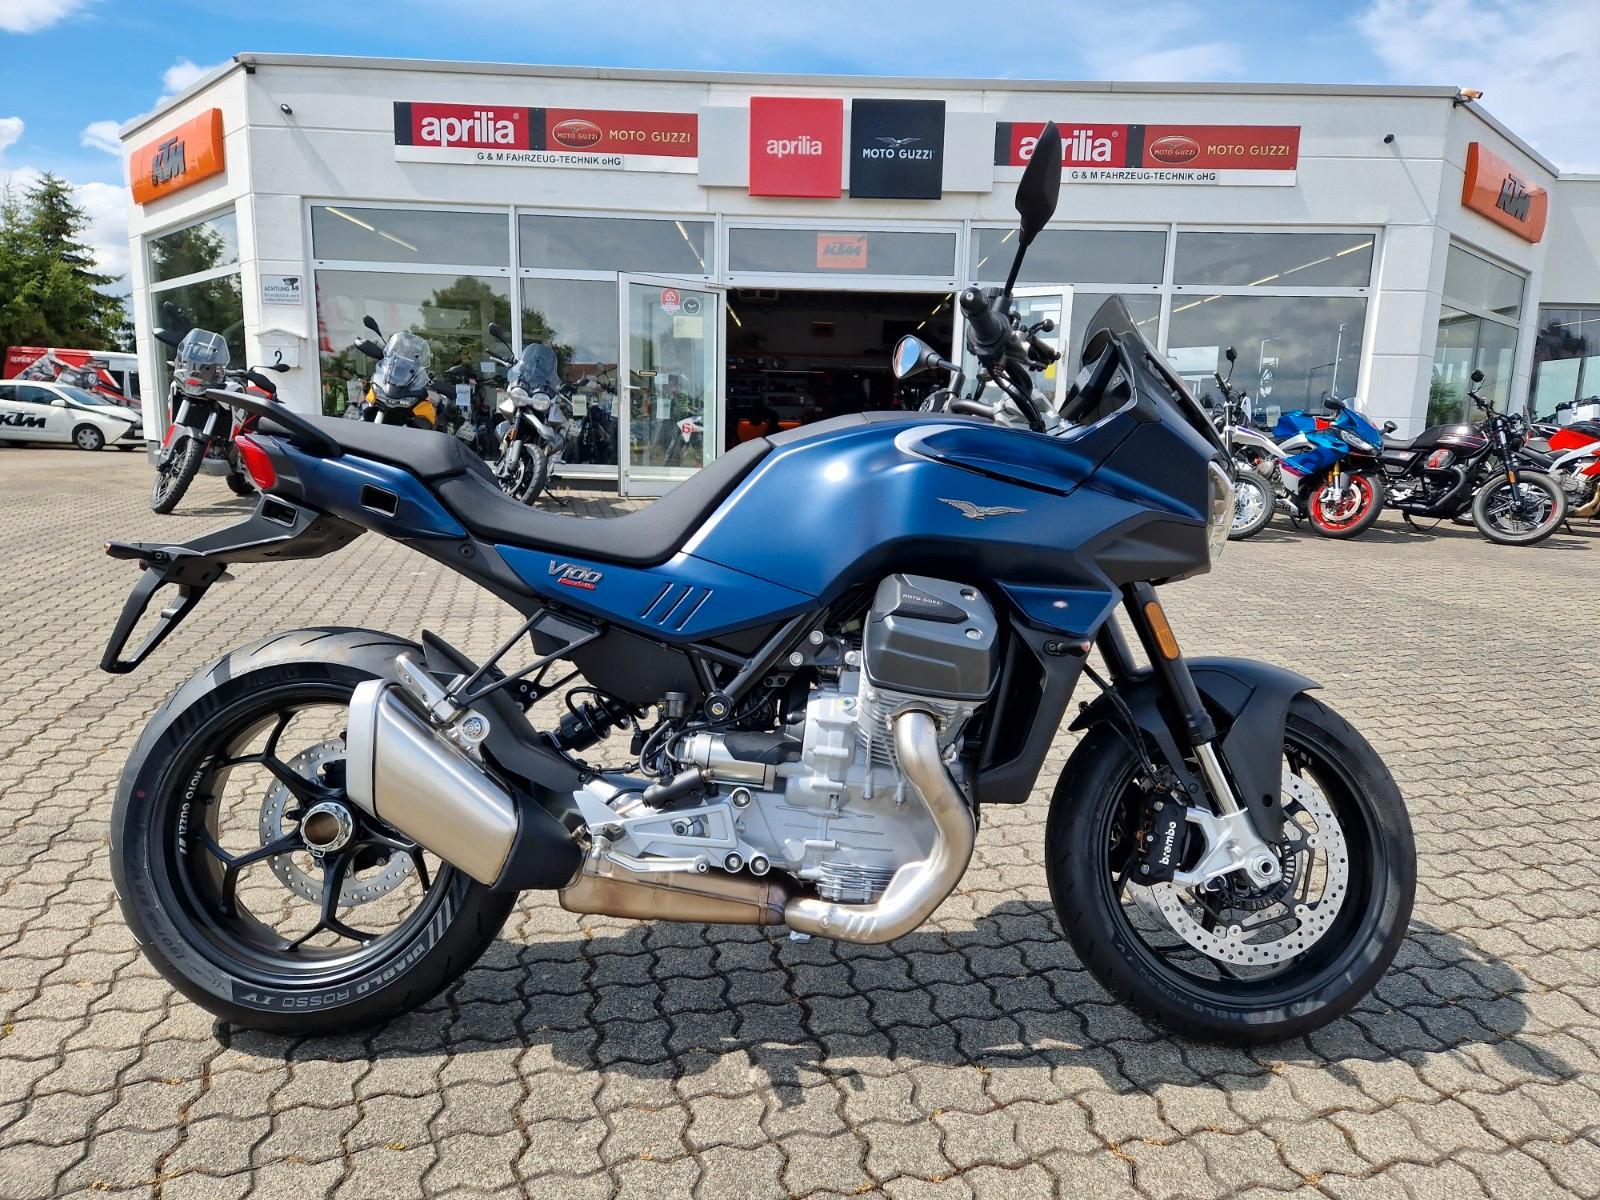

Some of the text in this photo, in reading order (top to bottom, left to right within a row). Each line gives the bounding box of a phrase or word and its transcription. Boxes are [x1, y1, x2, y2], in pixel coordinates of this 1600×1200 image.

[421, 111, 515, 147] aprilia
[609, 130, 690, 143] MOTO GUZZI
[766, 135, 822, 158] aprilia
[862, 148, 933, 160] MOTO GUZZI
[1019, 130, 1112, 162] arilia
[1207, 145, 1289, 156] MOTO GUZZI
[152, 136, 186, 187] KTM
[477, 152, 621, 166] G & M FAHRZEUG-TECHNIK oHG
[1072, 171, 1216, 181] G & M FAHRZEUG-TECHNIK oHG
[1496, 173, 1532, 223] KTM
[823, 242, 861, 257] KTM
[274, 349, 283, 365] 2
[548, 560, 603, 584] V100
[923, 597, 943, 605] GUZZI
[178, 770, 204, 835] MOTO GUZZI
[1159, 821, 1177, 866] brembo
[239, 943, 426, 1008] DIABLO ROSSO IV
